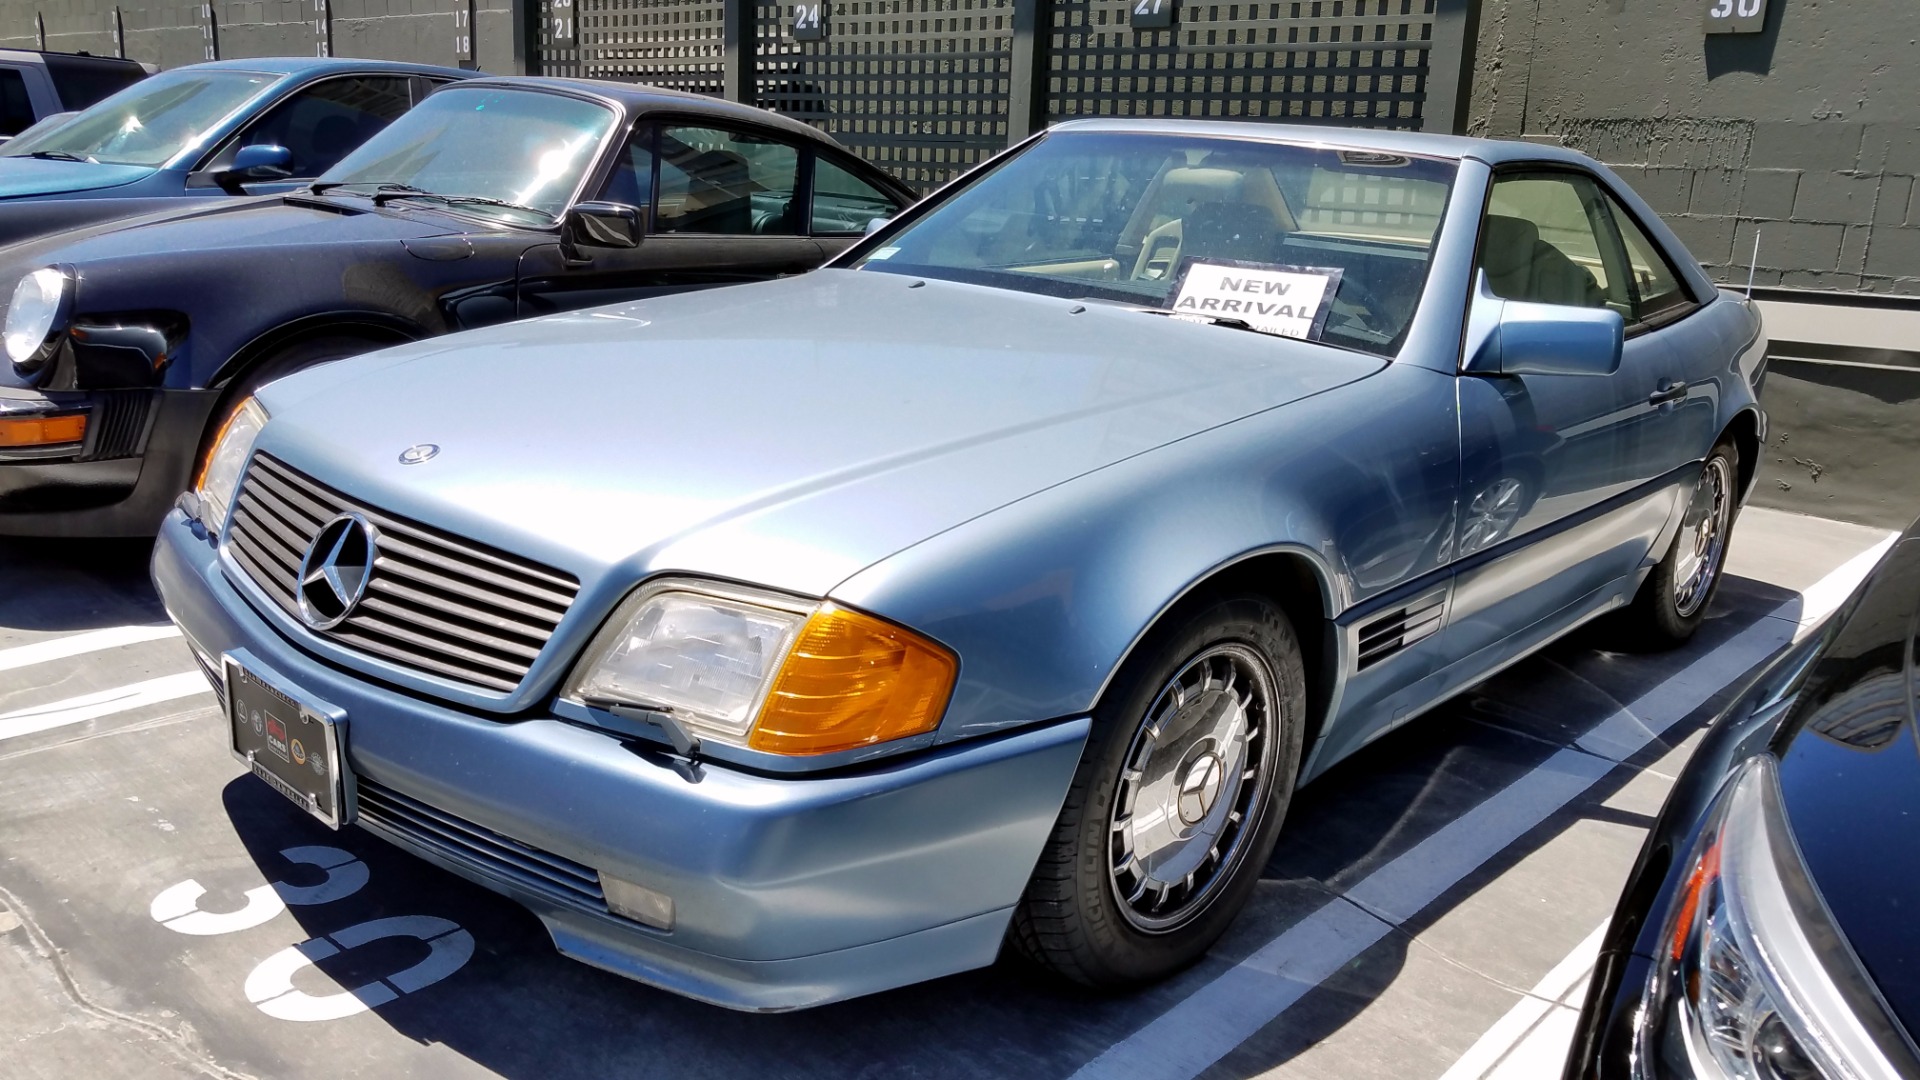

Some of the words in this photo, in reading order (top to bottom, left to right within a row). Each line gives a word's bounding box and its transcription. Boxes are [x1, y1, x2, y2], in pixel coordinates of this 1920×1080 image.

[455, 9, 469, 28] 17
[795, 4, 819, 29] 24
[315, 19, 327, 35] 14
[554, 17, 572, 39] 21
[205, 46, 215, 60] 12
[316, 42, 328, 57] 15
[456, 36, 470, 54] 18
[1219, 276, 1292, 297] NEW
[1177, 296, 1314, 320] ARRIVAL
[268, 735, 288, 753] CARS
[1084, 818, 1115, 947] MICHELIN
